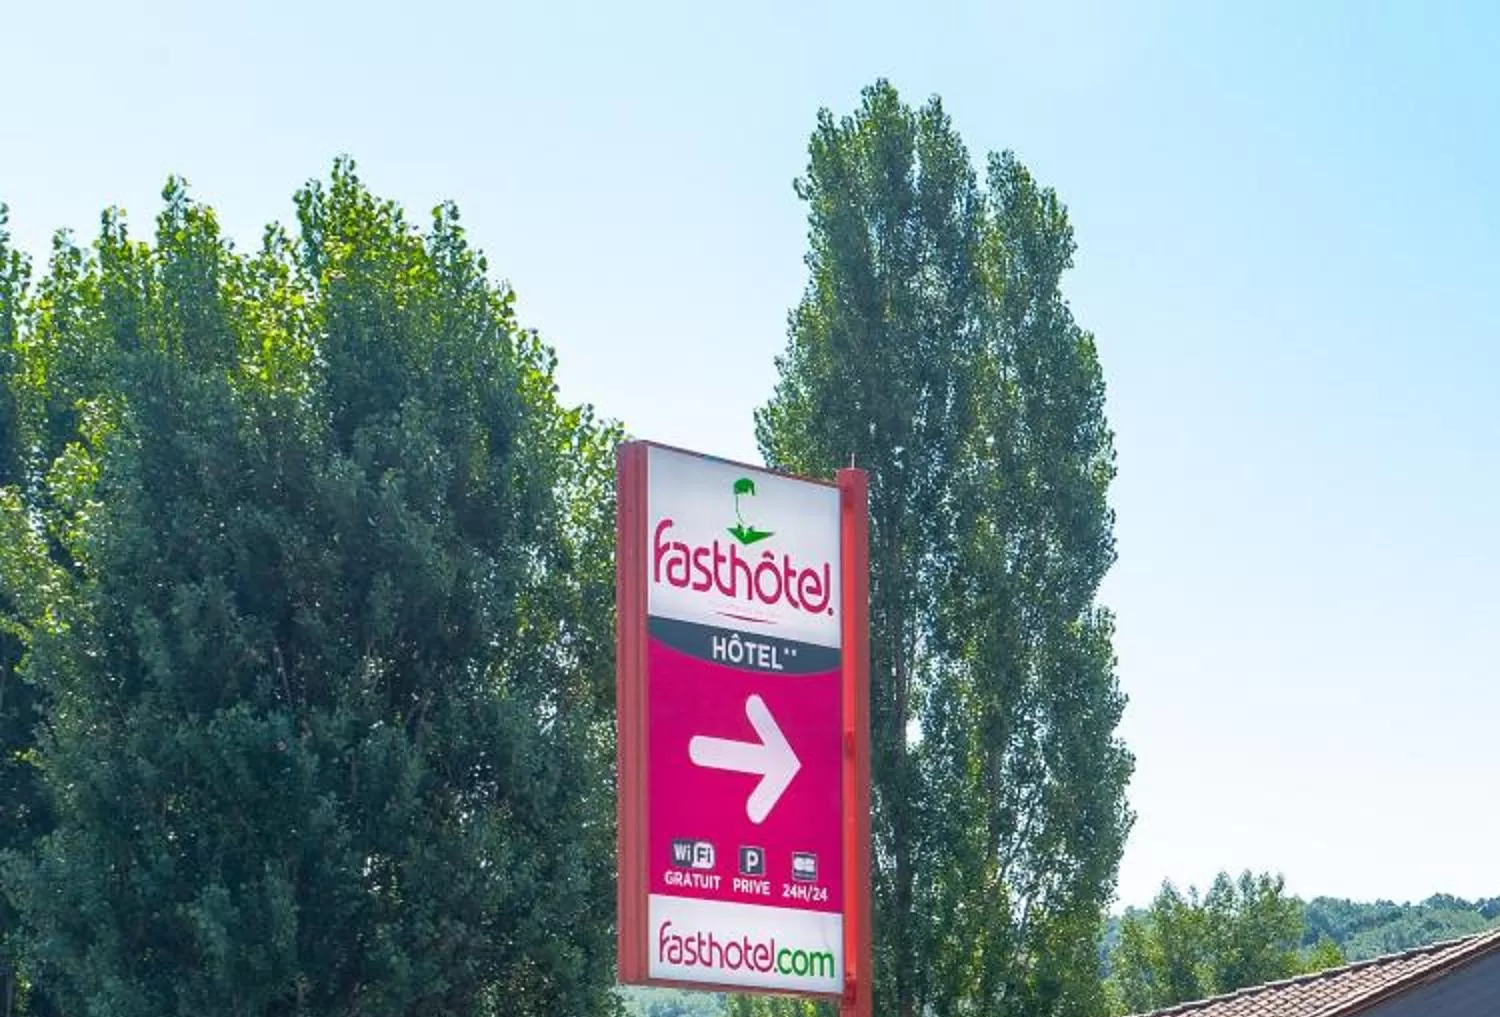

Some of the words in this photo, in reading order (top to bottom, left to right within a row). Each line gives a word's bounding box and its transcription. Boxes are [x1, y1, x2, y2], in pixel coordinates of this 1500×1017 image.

[664, 870, 721, 891] GRATUIT
[732, 878, 770, 896] PRIVE
[782, 884, 828, 902] 24H/24
[659, 921, 835, 978] fasthotel.com
